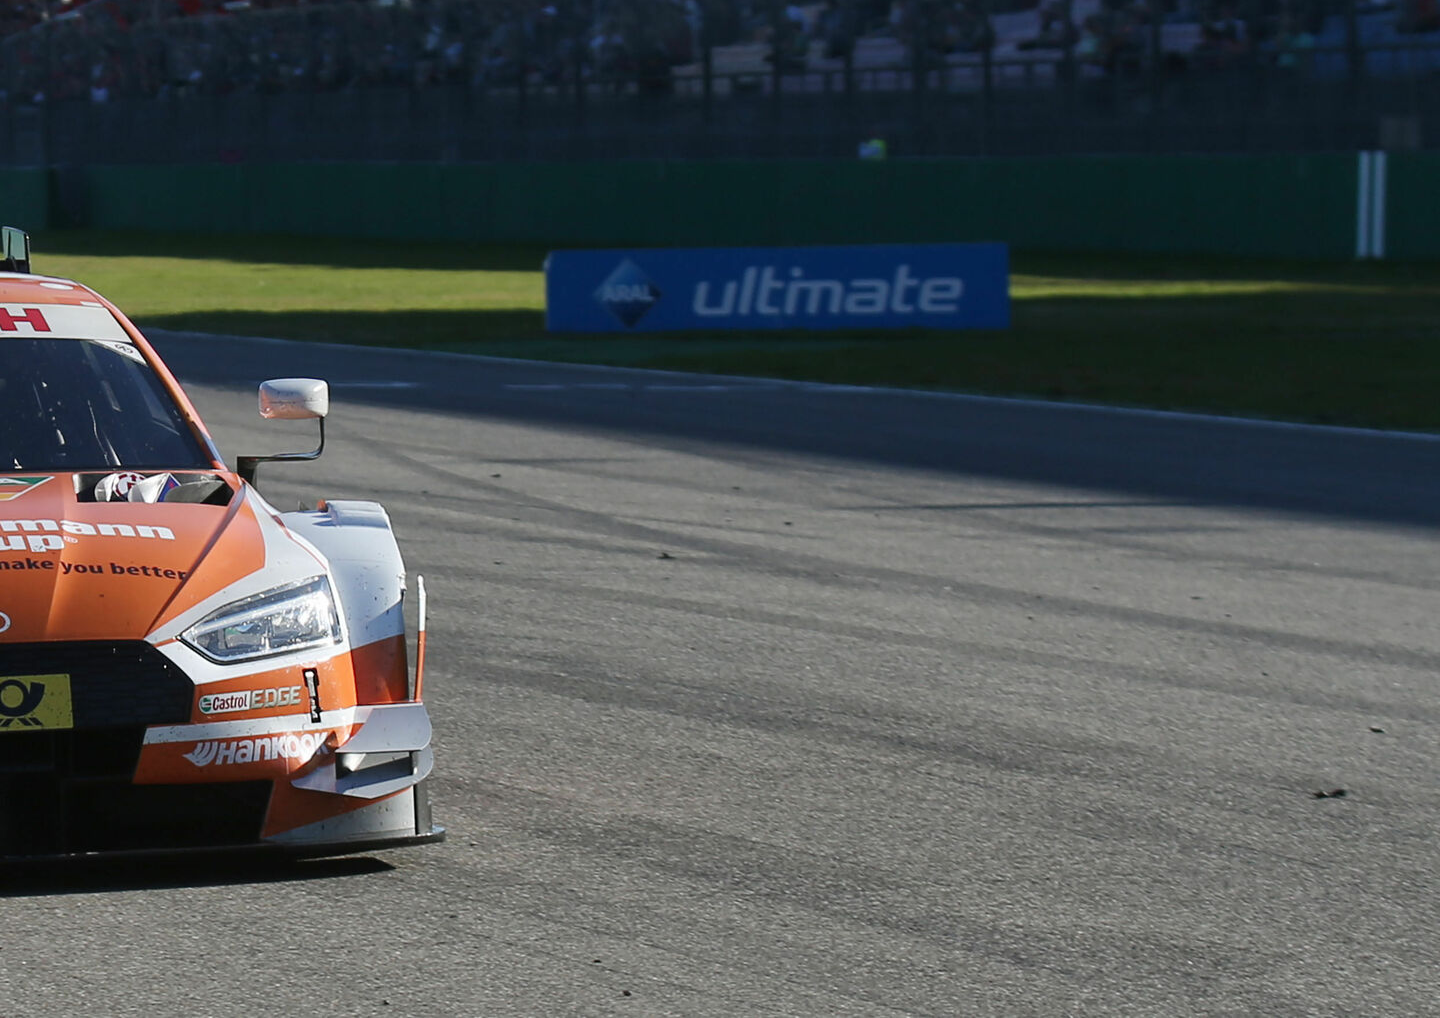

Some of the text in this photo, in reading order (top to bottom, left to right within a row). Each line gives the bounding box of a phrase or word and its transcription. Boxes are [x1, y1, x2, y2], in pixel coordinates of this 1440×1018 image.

[693, 265, 963, 316] ultimate
[61, 561, 104, 577] you
[110, 562, 188, 581] better
[212, 686, 302, 711] Castrol EDGE
